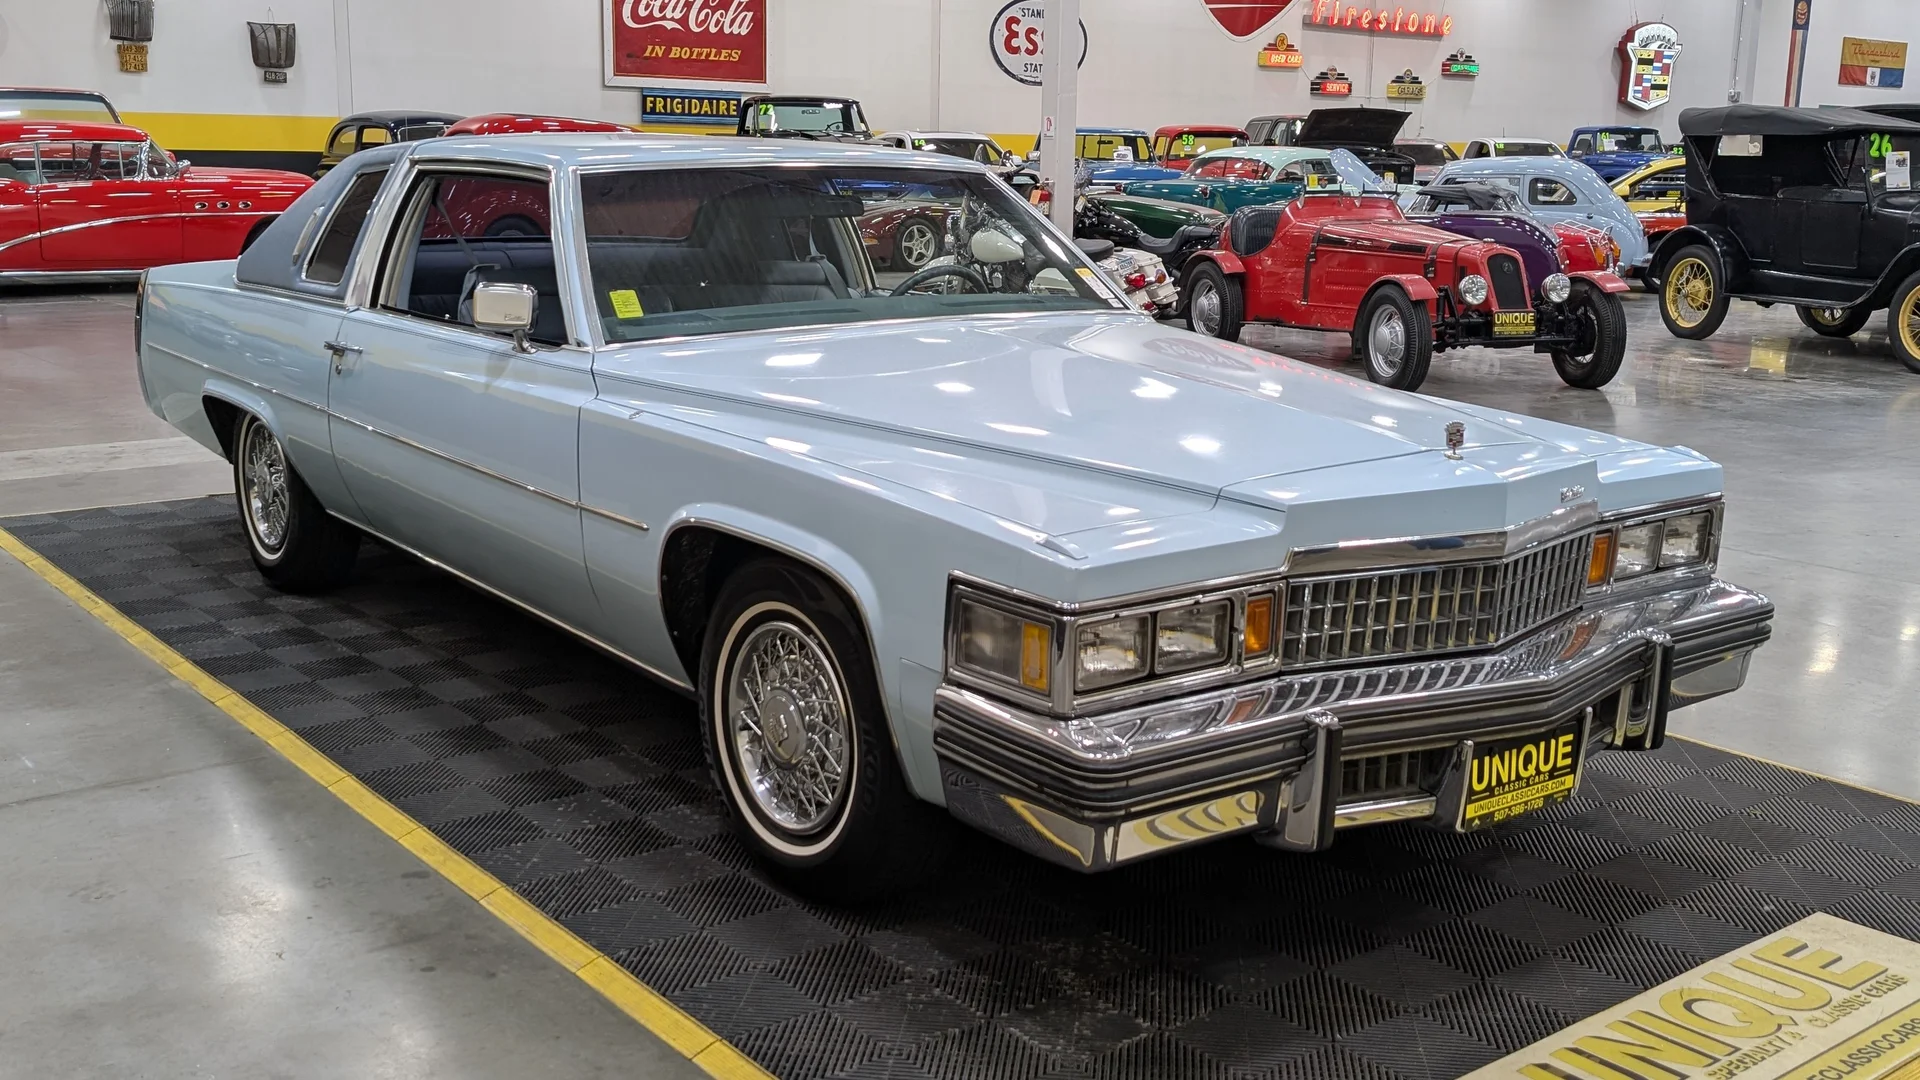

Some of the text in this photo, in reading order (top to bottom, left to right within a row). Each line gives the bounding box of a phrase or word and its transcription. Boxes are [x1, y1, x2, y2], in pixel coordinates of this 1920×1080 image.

[643, 45, 742, 61] IN BOTTLES
[1270, 54, 1303, 64] USED CARS
[1023, 63, 1043, 73] STAT
[1326, 83, 1349, 92] SERVICE
[646, 97, 738, 115] FRIGIDAIRE
[759, 104, 774, 116] 72
[1182, 134, 1195, 145] 58
[1869, 132, 1893, 158] 26
[1494, 312, 1535, 324] UNIQUE
[1472, 735, 1574, 790] UNIQUE
[1494, 772, 1550, 795] CLASSIC CARS
[1473, 778, 1567, 814] UNIQUECLASSICCARS.COM
[1806, 994, 1872, 1028] CLASSIC
[1860, 974, 1910, 998] CARS
